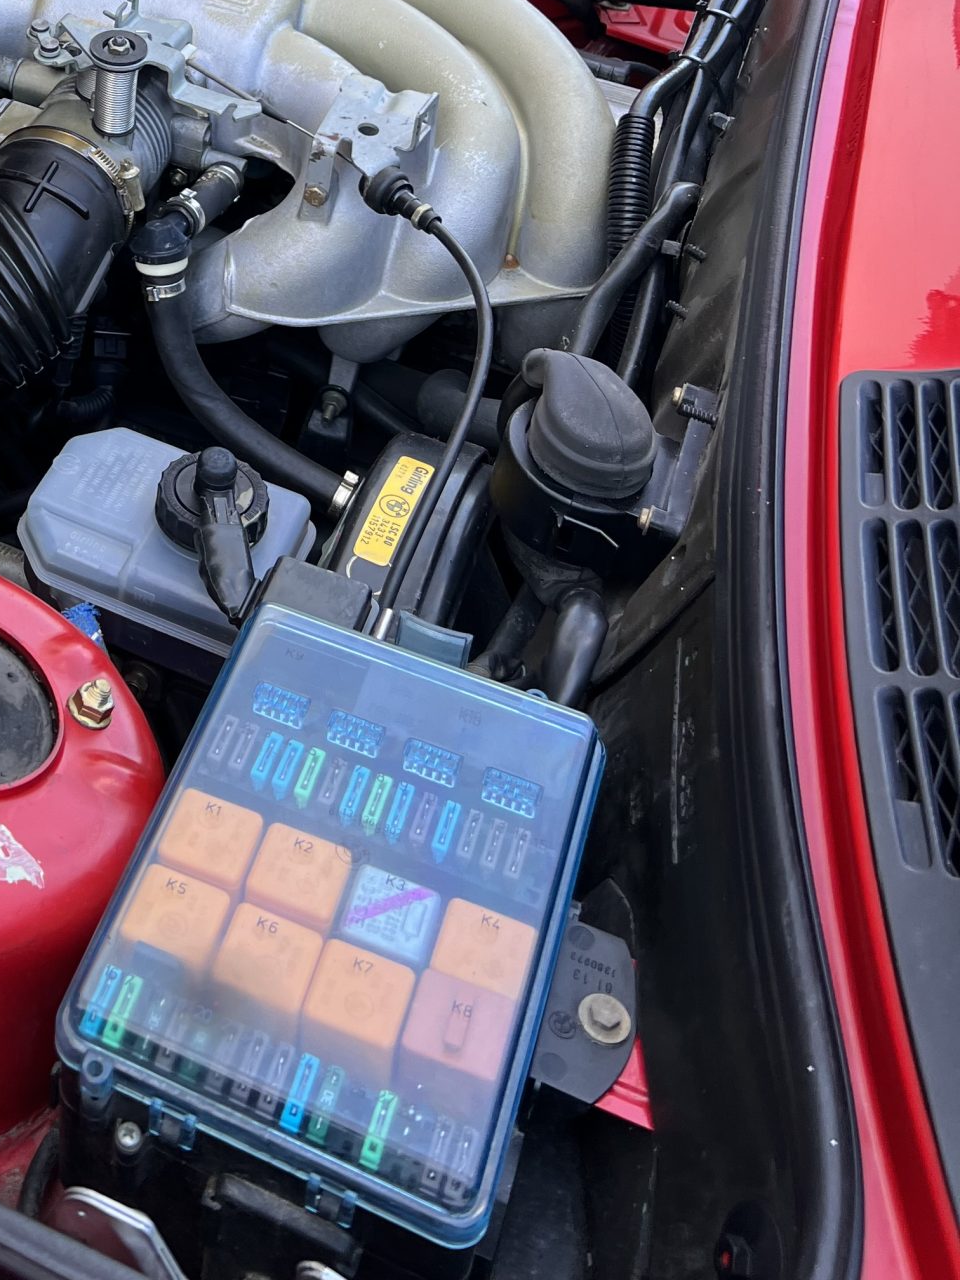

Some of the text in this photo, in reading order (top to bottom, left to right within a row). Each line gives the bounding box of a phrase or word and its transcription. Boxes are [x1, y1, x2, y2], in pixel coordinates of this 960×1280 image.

[401, 466, 429, 495] Girling
[204, 801, 223, 817] K1
[293, 837, 314, 854] K2
[165, 877, 188, 895] K5
[385, 874, 406, 891] K3
[256, 916, 280, 934] K6
[480, 913, 501, 931] K4
[353, 956, 374, 975] K7
[451, 1000, 474, 1019] K8
